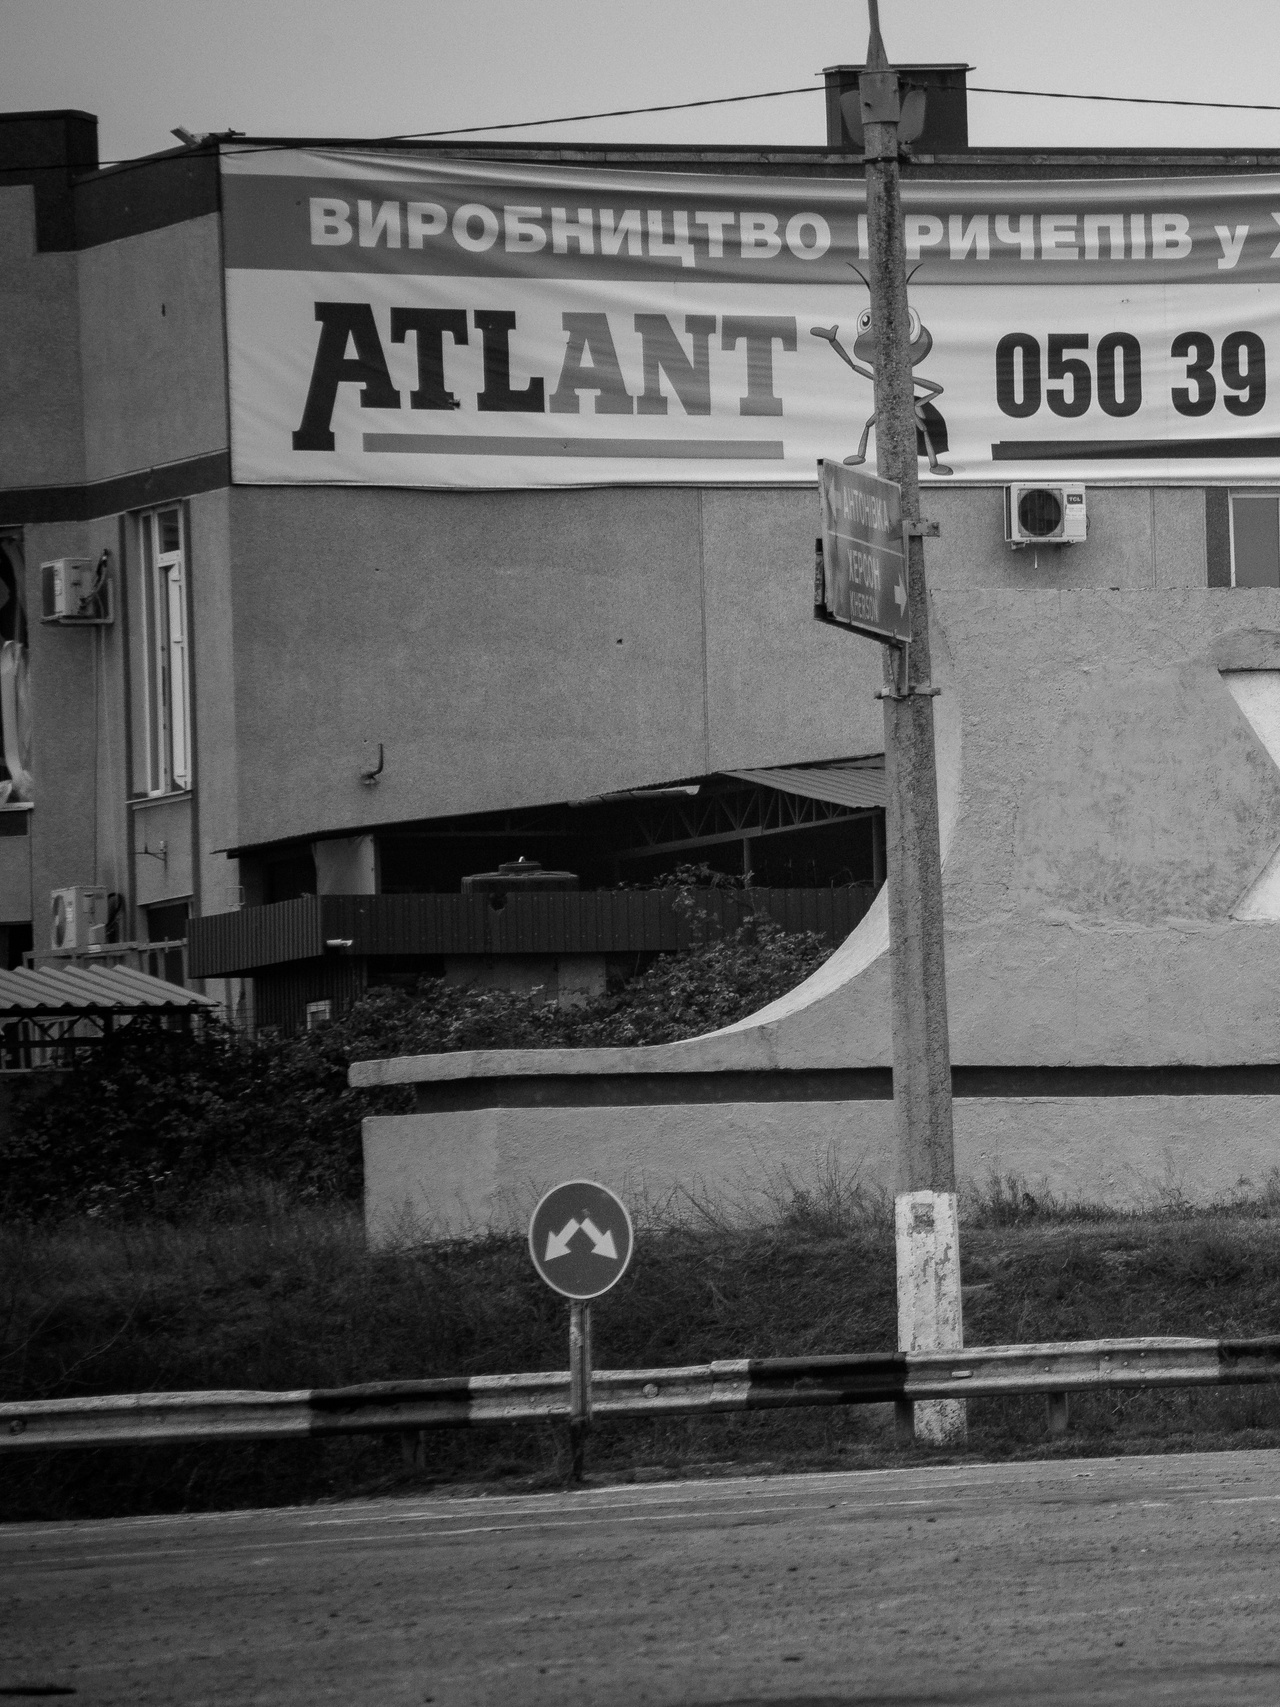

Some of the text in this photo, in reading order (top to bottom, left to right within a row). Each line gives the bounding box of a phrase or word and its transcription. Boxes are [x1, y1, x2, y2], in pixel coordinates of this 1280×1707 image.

[309, 197, 831, 267] ВИРОБНИЦТВО
[857, 212, 1193, 260] РИЧЕПІВ
[292, 301, 798, 451] ATLANT
[995, 331, 1142, 418] 050
[1170, 330, 1267, 417] 39
[846, 548, 881, 592] ХЕРСОН
